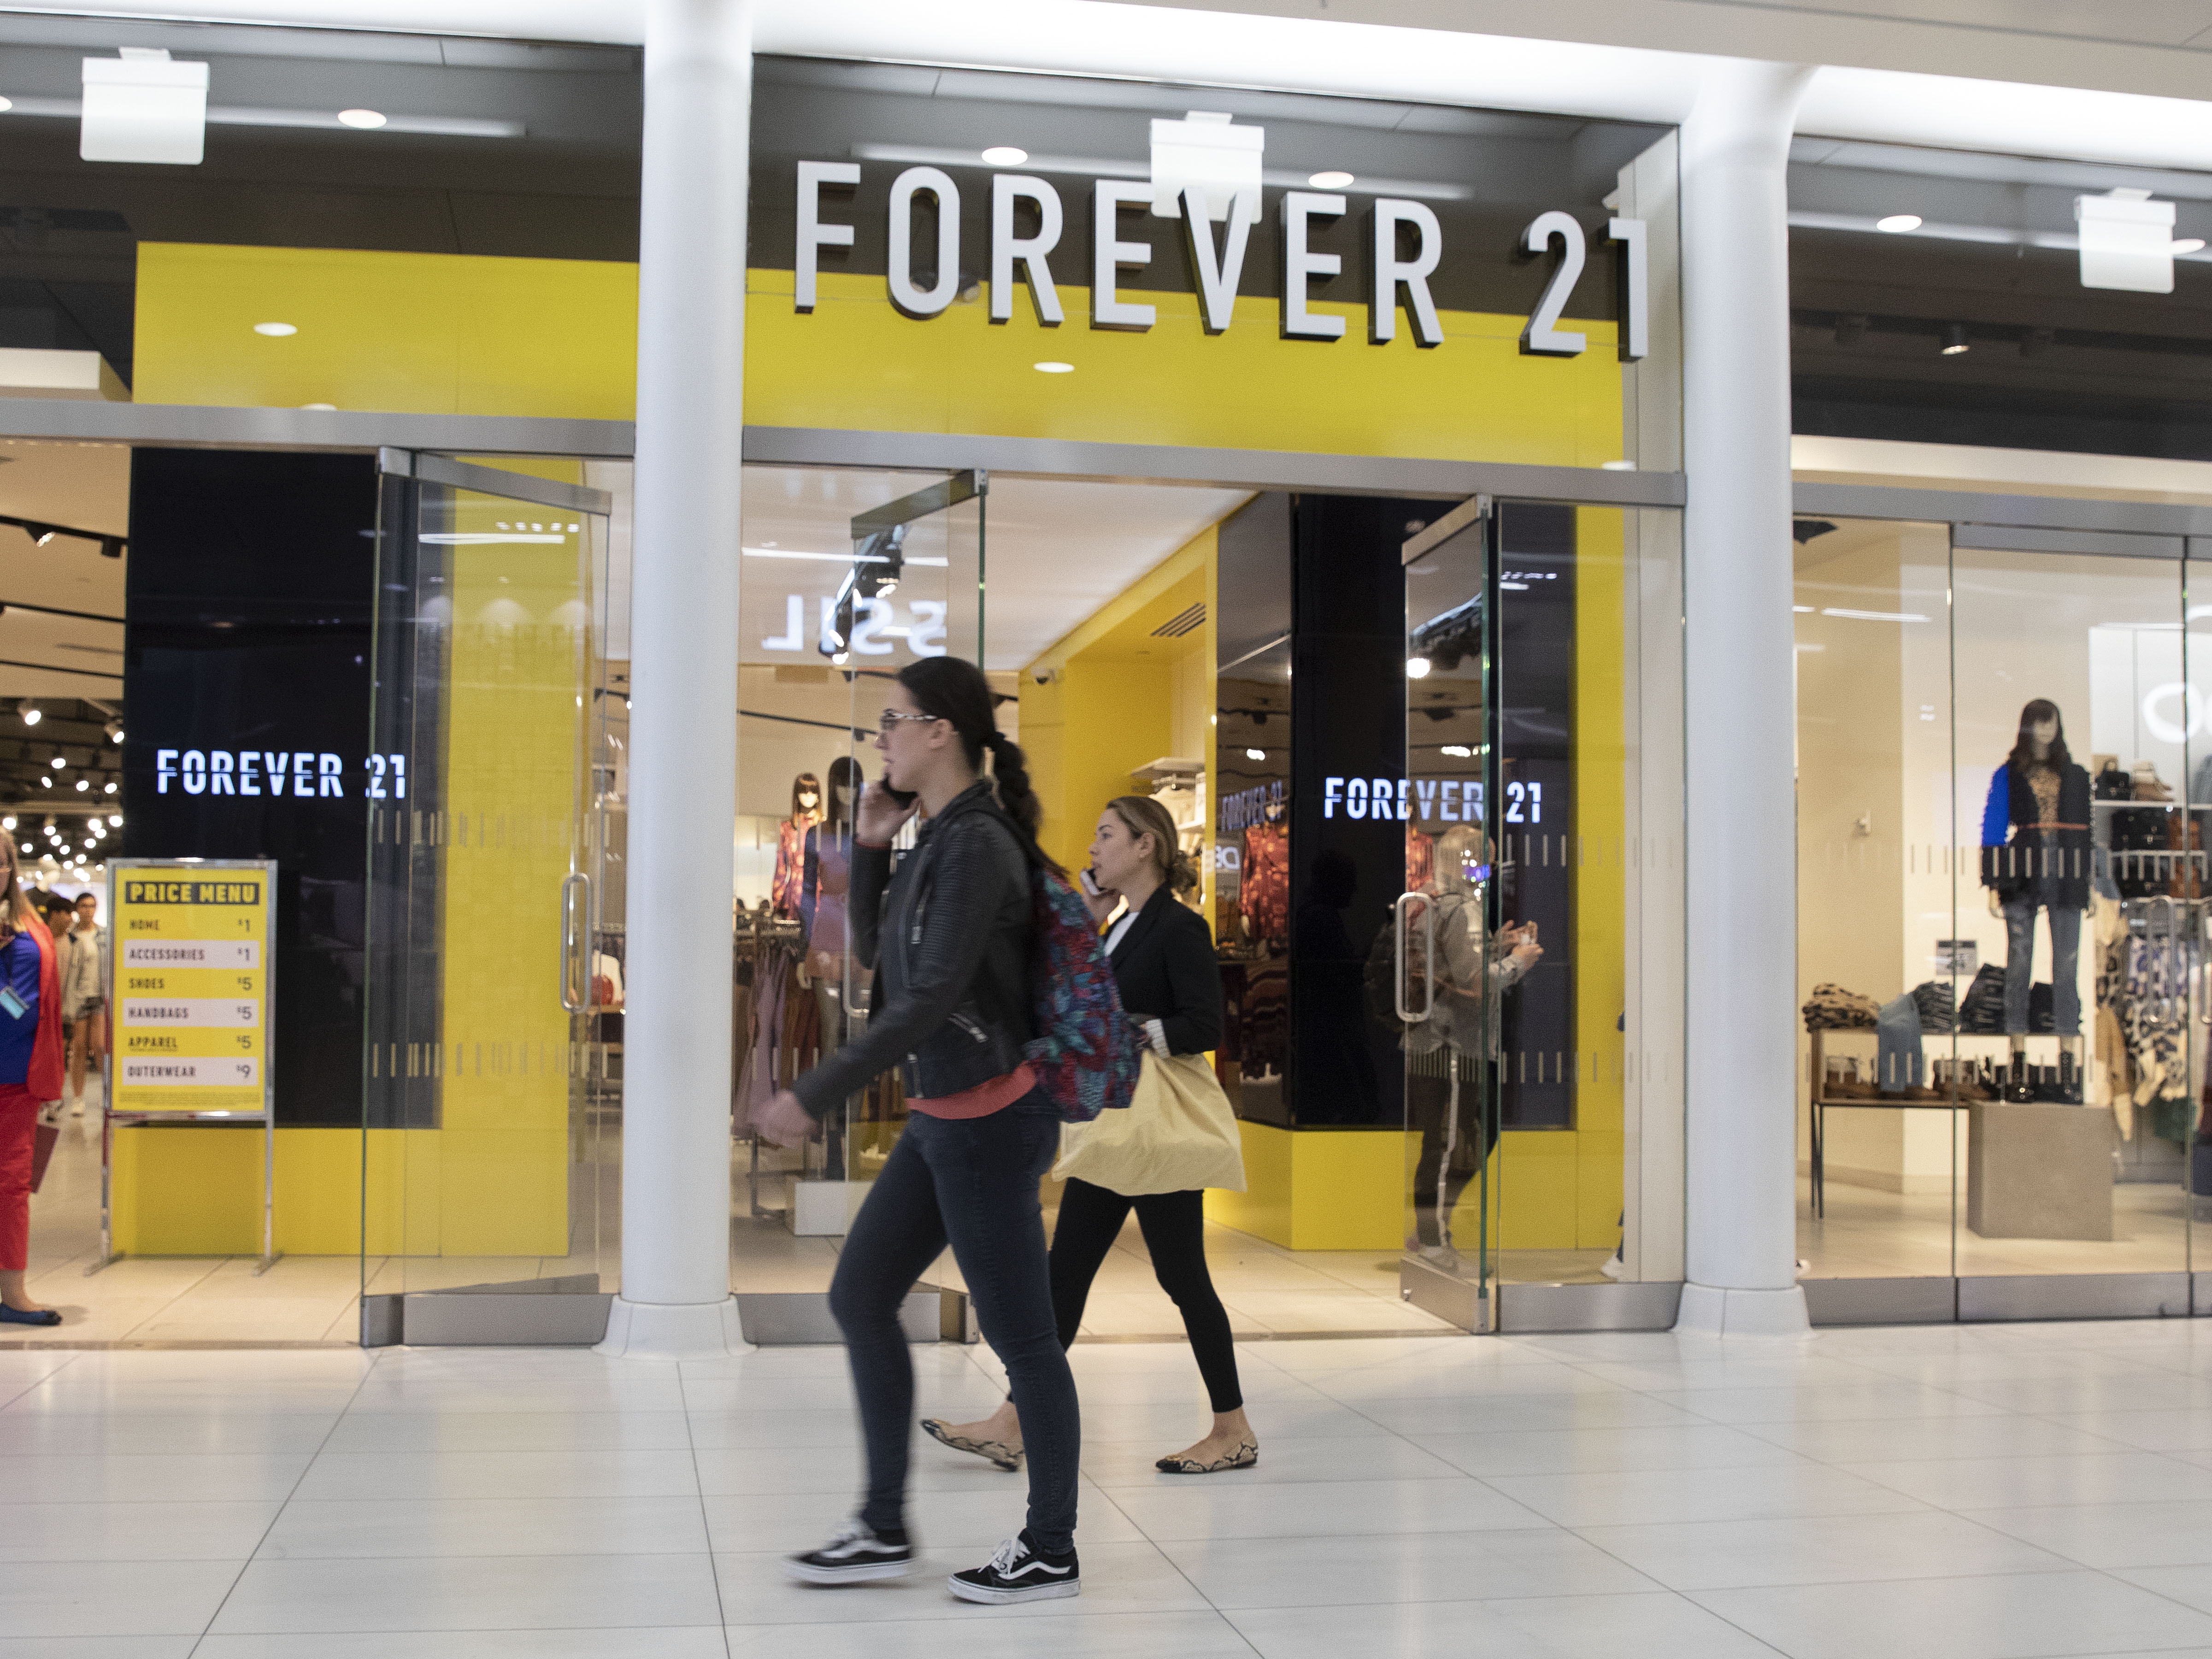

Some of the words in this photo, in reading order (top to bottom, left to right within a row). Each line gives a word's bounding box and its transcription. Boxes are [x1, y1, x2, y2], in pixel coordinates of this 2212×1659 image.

[795, 159, 1444, 349] FOREVER
[1518, 210, 1648, 362] 21
[157, 749, 344, 798] FOREVER
[365, 753, 406, 799] 21
[1324, 777, 1484, 822] FOREVER
[1506, 782, 1542, 823] 21
[130, 883, 191, 902] PRICE
[199, 885, 255, 903] MENU
[129, 949, 206, 961] ACCESSORIES
[129, 977, 165, 989] SHOES
[128, 1007, 189, 1019] HANDBAGS
[128, 1037, 177, 1048] APPAREL
[127, 1066, 196, 1077] OUTERWEAR
